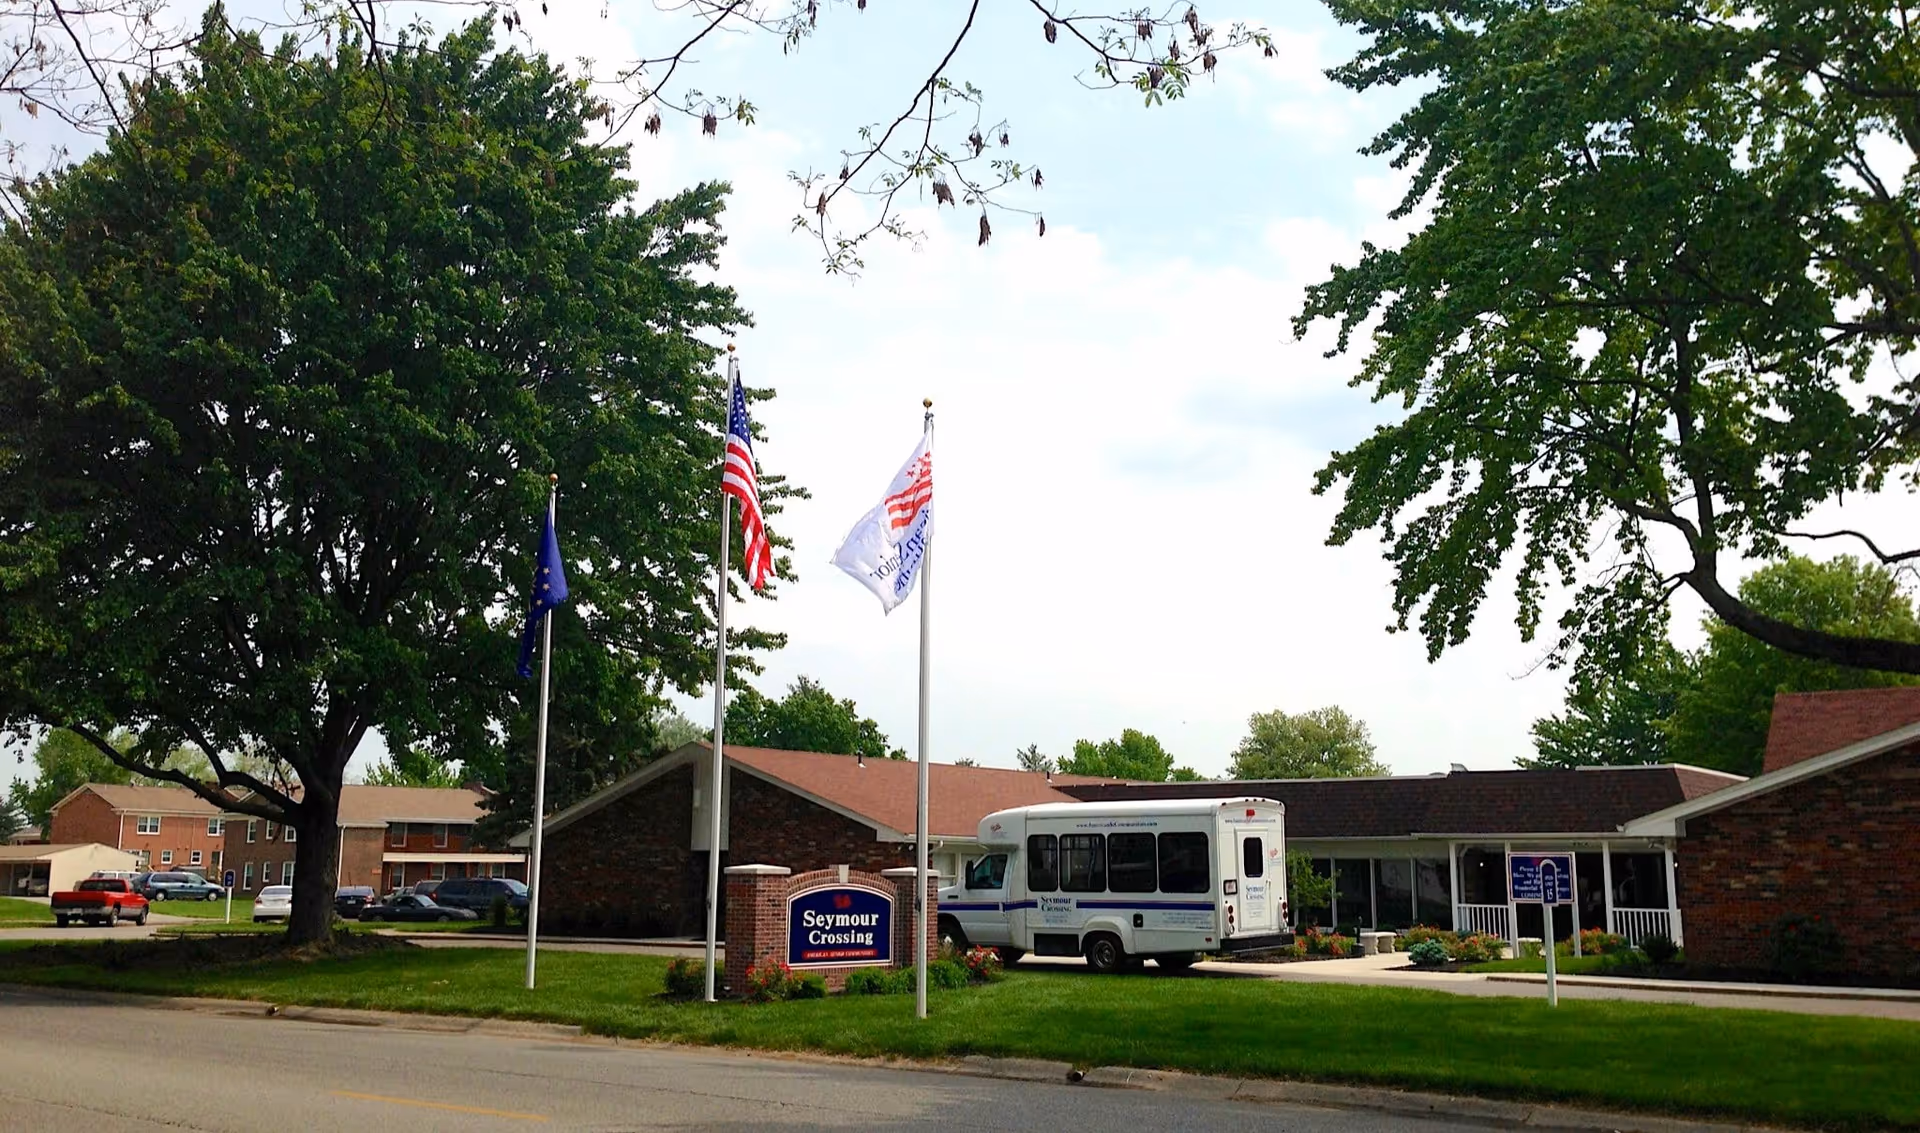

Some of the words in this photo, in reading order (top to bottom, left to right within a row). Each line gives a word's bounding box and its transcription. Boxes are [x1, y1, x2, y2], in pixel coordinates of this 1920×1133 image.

[1546, 889, 1553, 900] 15
[803, 910, 879, 930] Seymour
[808, 930, 873, 945] Crossing
